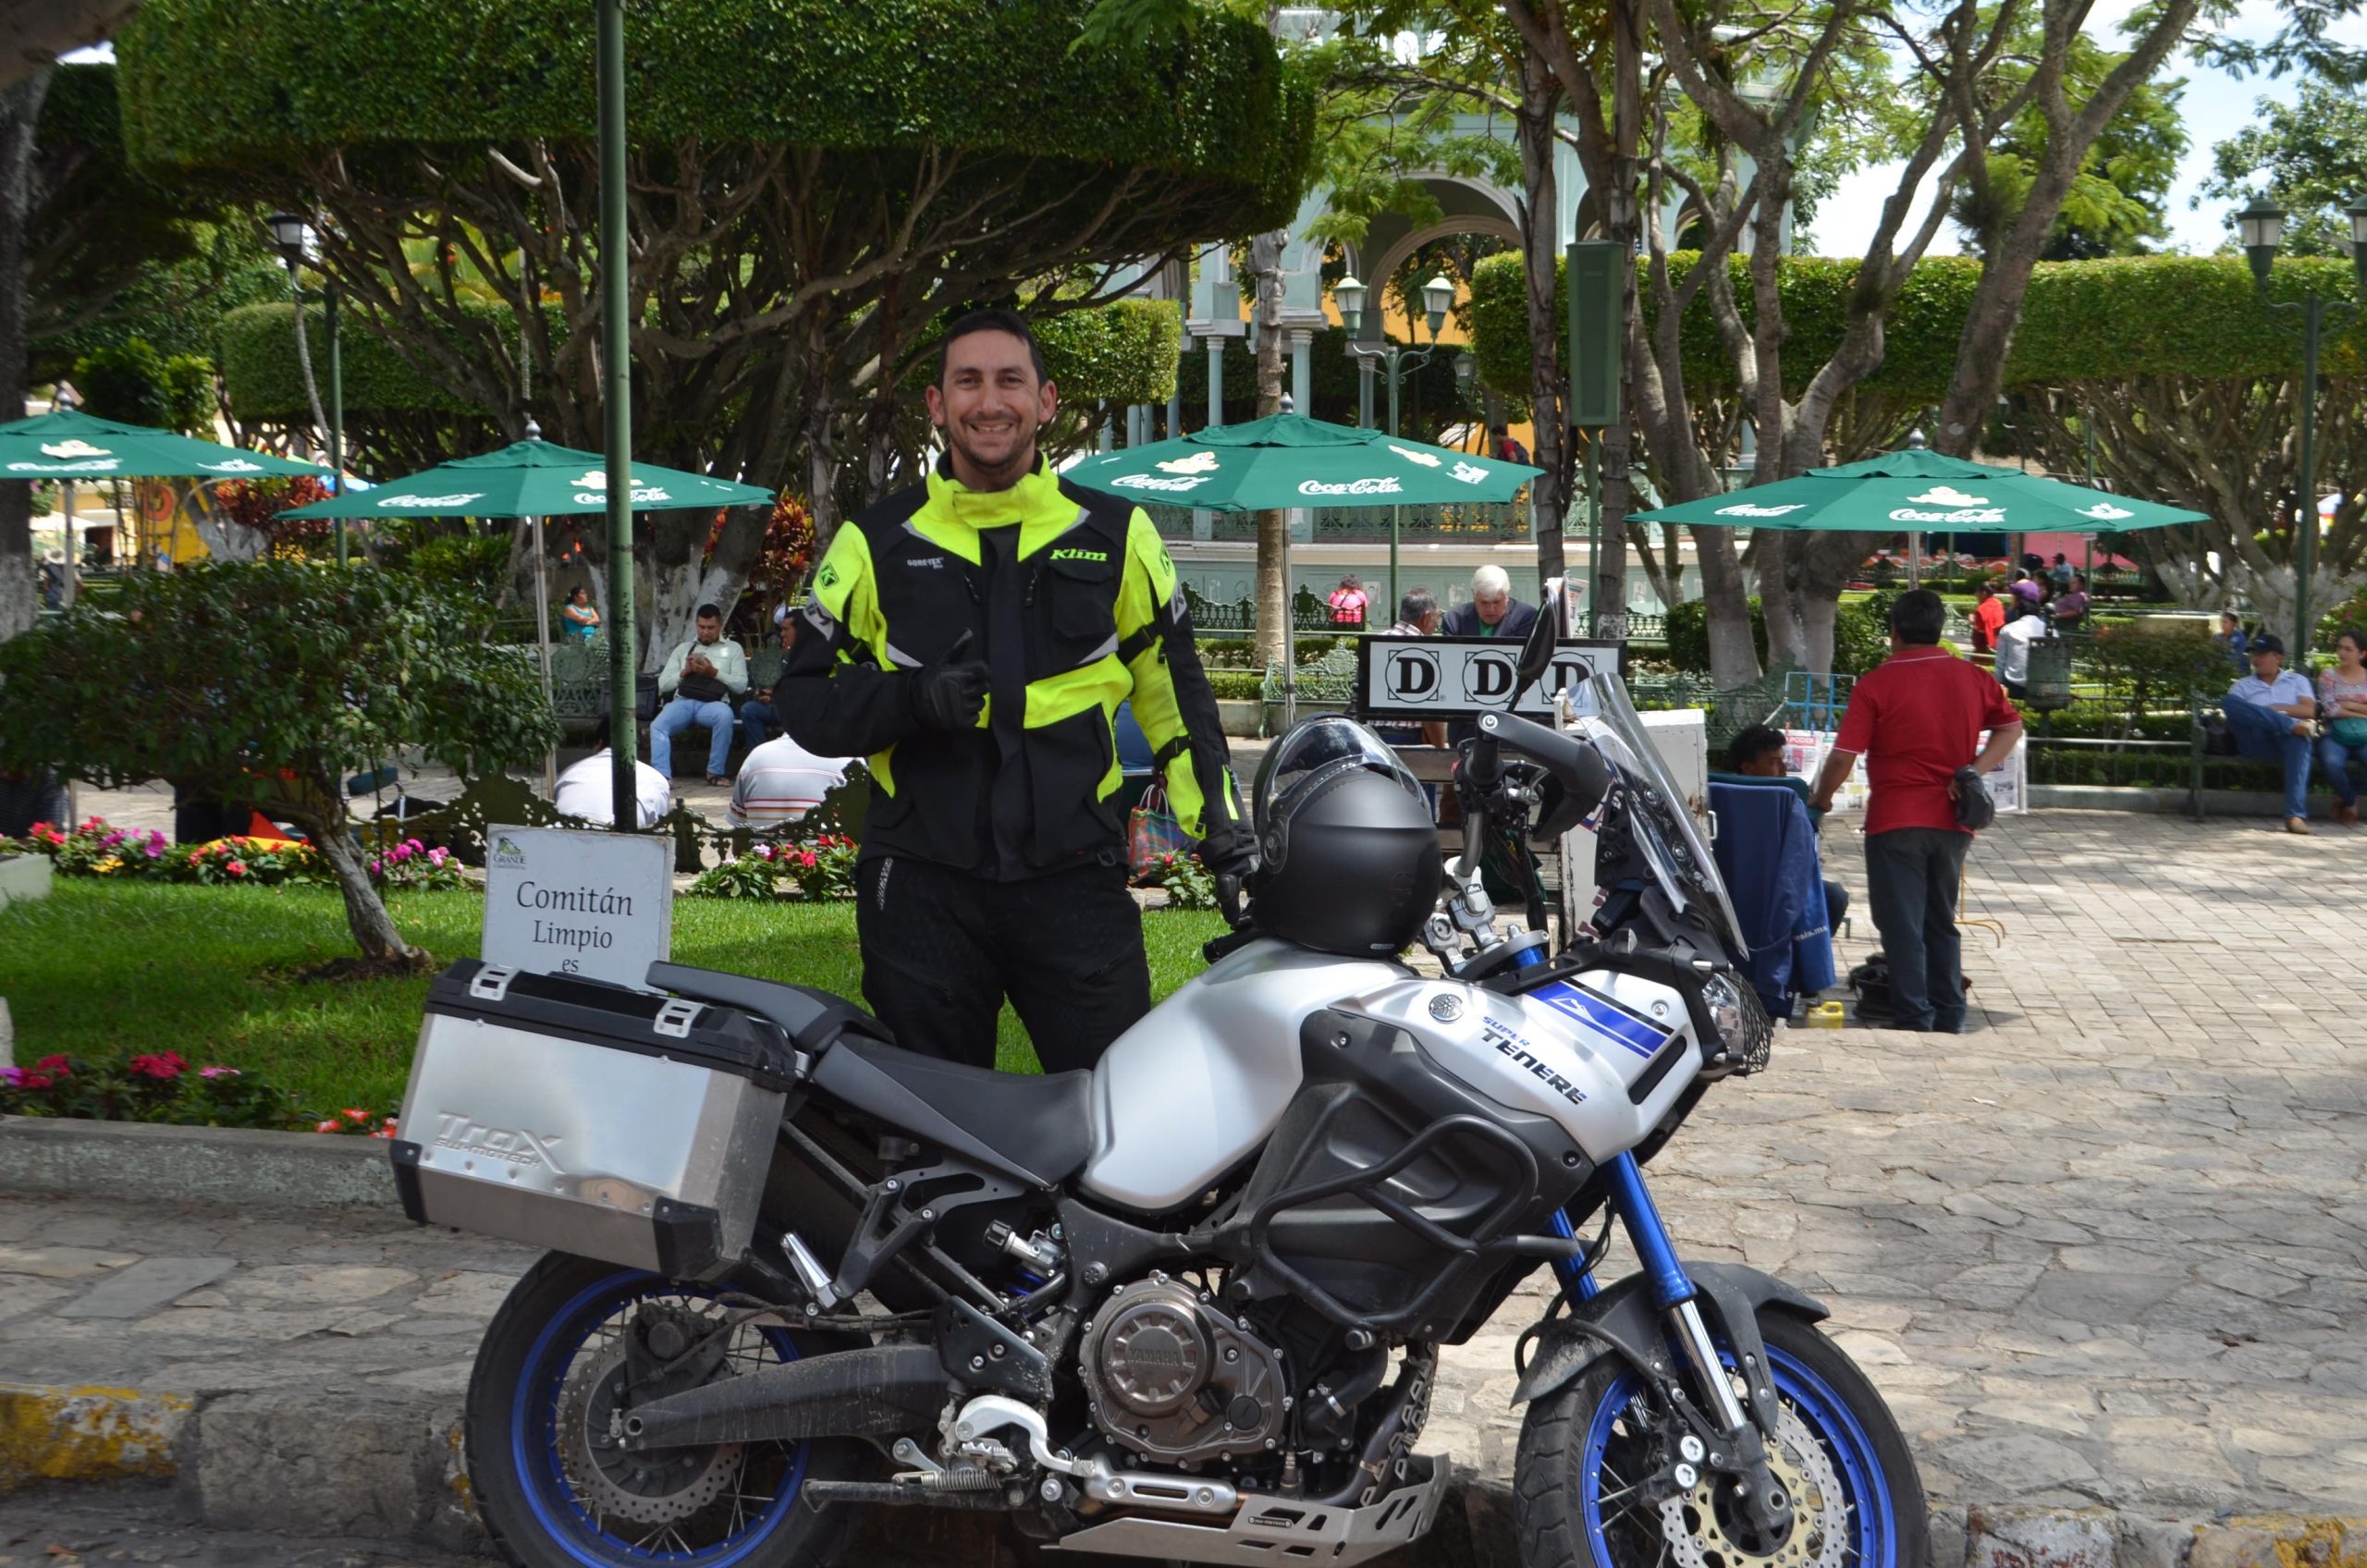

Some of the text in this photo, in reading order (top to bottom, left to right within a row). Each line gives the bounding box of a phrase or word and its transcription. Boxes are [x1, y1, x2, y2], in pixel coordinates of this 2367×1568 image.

[1297, 476, 1404, 495] Coca-Cola
[1888, 508, 2006, 523] Coca-Cola
[1049, 548, 1108, 562] Klim
[1396, 657, 1435, 693] D
[1473, 659, 1512, 695] D
[517, 881, 632, 915] Comitán
[533, 920, 613, 952] Limpio
[561, 959, 580, 973] es
[1482, 1015, 1530, 1047] SUPER
